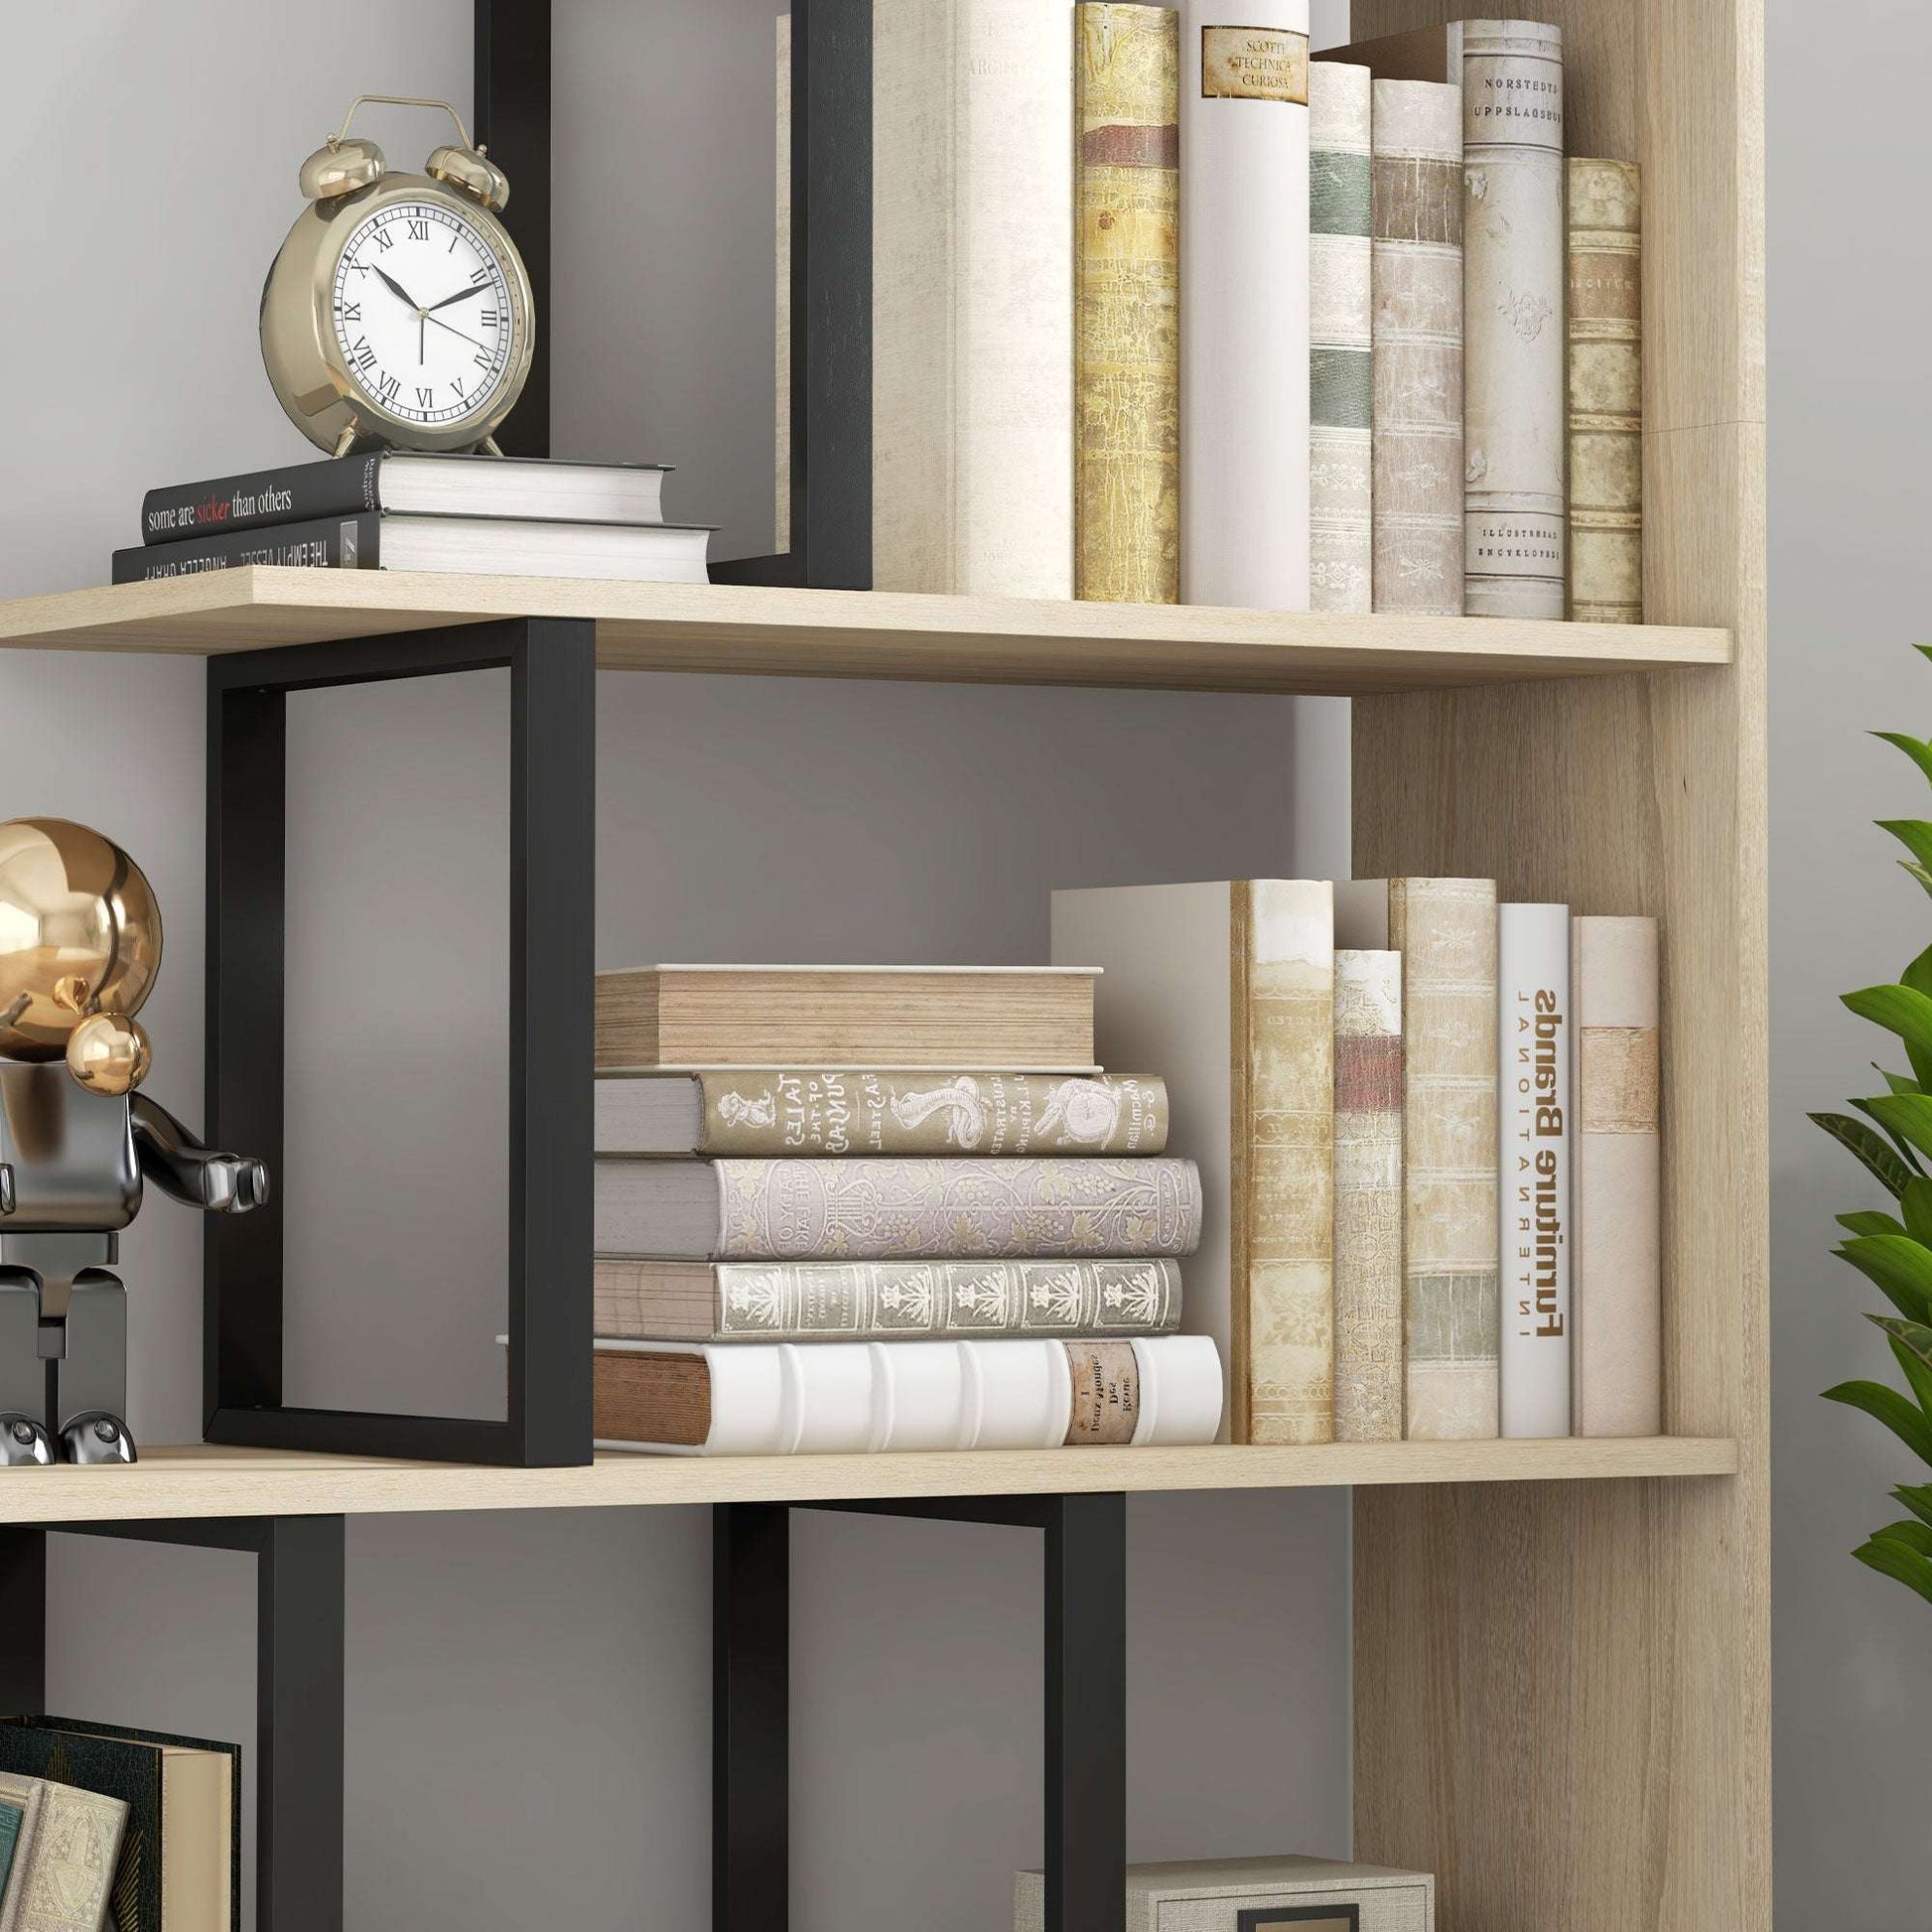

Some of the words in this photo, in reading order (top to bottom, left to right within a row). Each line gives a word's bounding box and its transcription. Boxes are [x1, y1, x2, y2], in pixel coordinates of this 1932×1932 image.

[1242, 73, 1289, 89] CURIOSA
[1484, 78, 1558, 95] NORSTEDTS
[371, 227, 394, 253] XI
[407, 219, 429, 241] XII
[350, 257, 370, 279] X
[470, 267, 487, 285] II
[344, 301, 361, 323] IX
[481, 309, 497, 329] III
[352, 335, 377, 371] VIII
[474, 345, 493, 371] IV
[378, 370, 402, 400] VII
[450, 376, 465, 398] V
[416, 387, 434, 408] VI
[148, 507, 176, 532] some
[178, 504, 196, 526] are
[196, 493, 231, 524] sicker
[232, 489, 256, 518] than
[257, 483, 292, 514] others
[311, 540, 329, 568] THE
